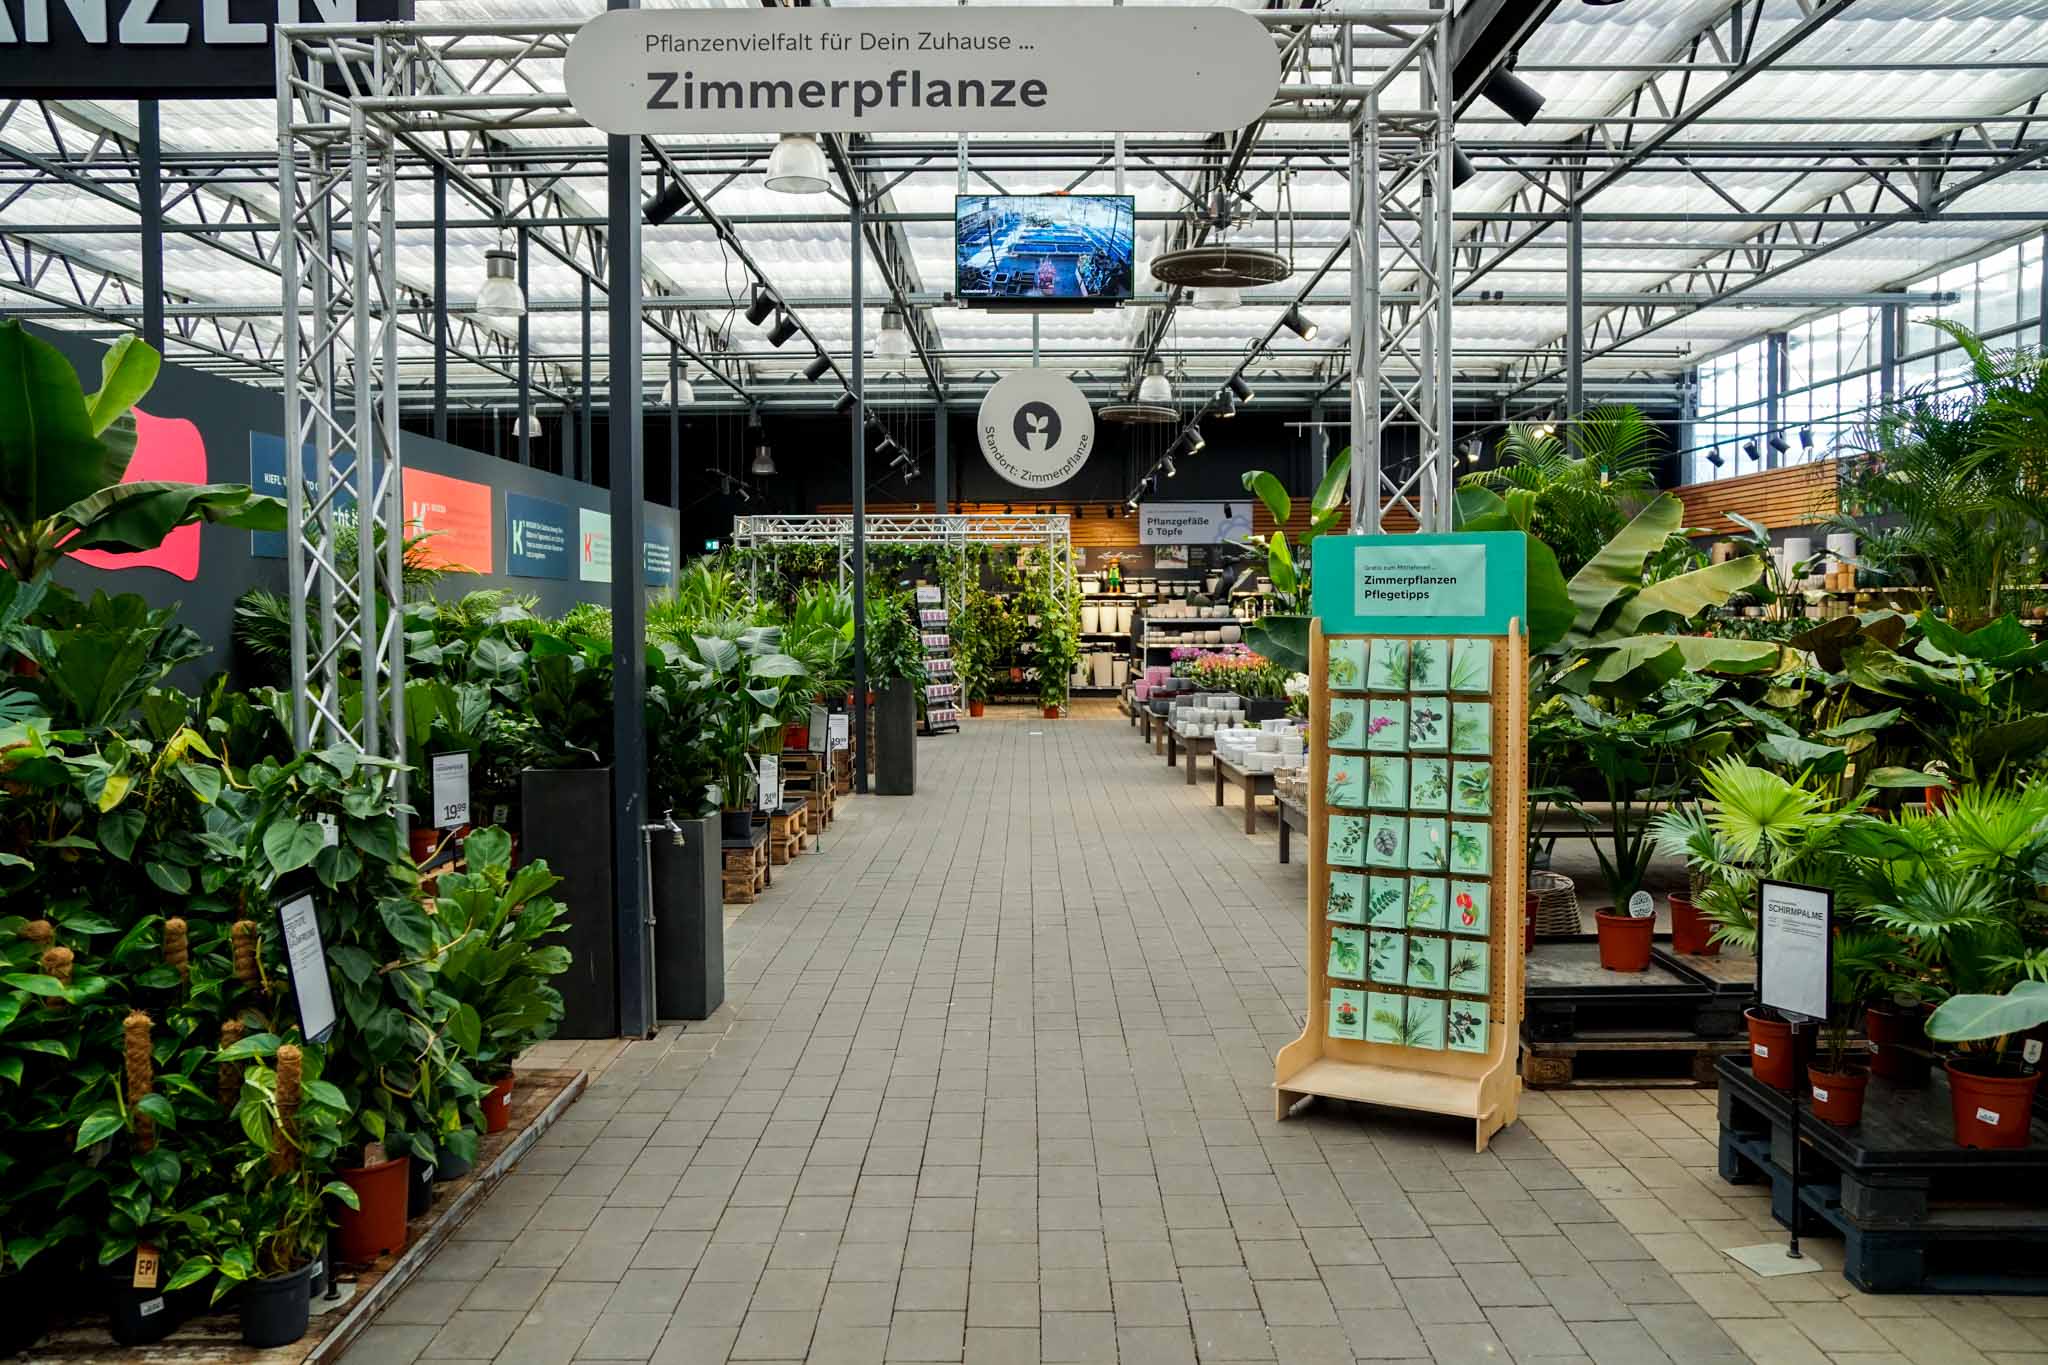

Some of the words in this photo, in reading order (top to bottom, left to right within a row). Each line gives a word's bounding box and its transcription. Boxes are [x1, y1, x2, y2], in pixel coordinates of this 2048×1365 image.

[645, 33, 813, 53] Pflanzenvielfalt
[820, 33, 852, 52] für
[859, 31, 910, 51] Dein
[917, 31, 1012, 51] Zuhause
[646, 69, 1048, 118] Zimmerpflanze
[985, 425, 1019, 477] Standort:
[1020, 433, 1089, 483] Zimmerpflanze
[1147, 517, 1209, 527] Pflanzgefäße
[1157, 527, 1183, 537] Töpfe
[1364, 575, 1457, 587] Zimmerpflanzen
[1364, 589, 1430, 601] Pflegetipps
[1767, 903, 1824, 921] SCHIRMPALME
